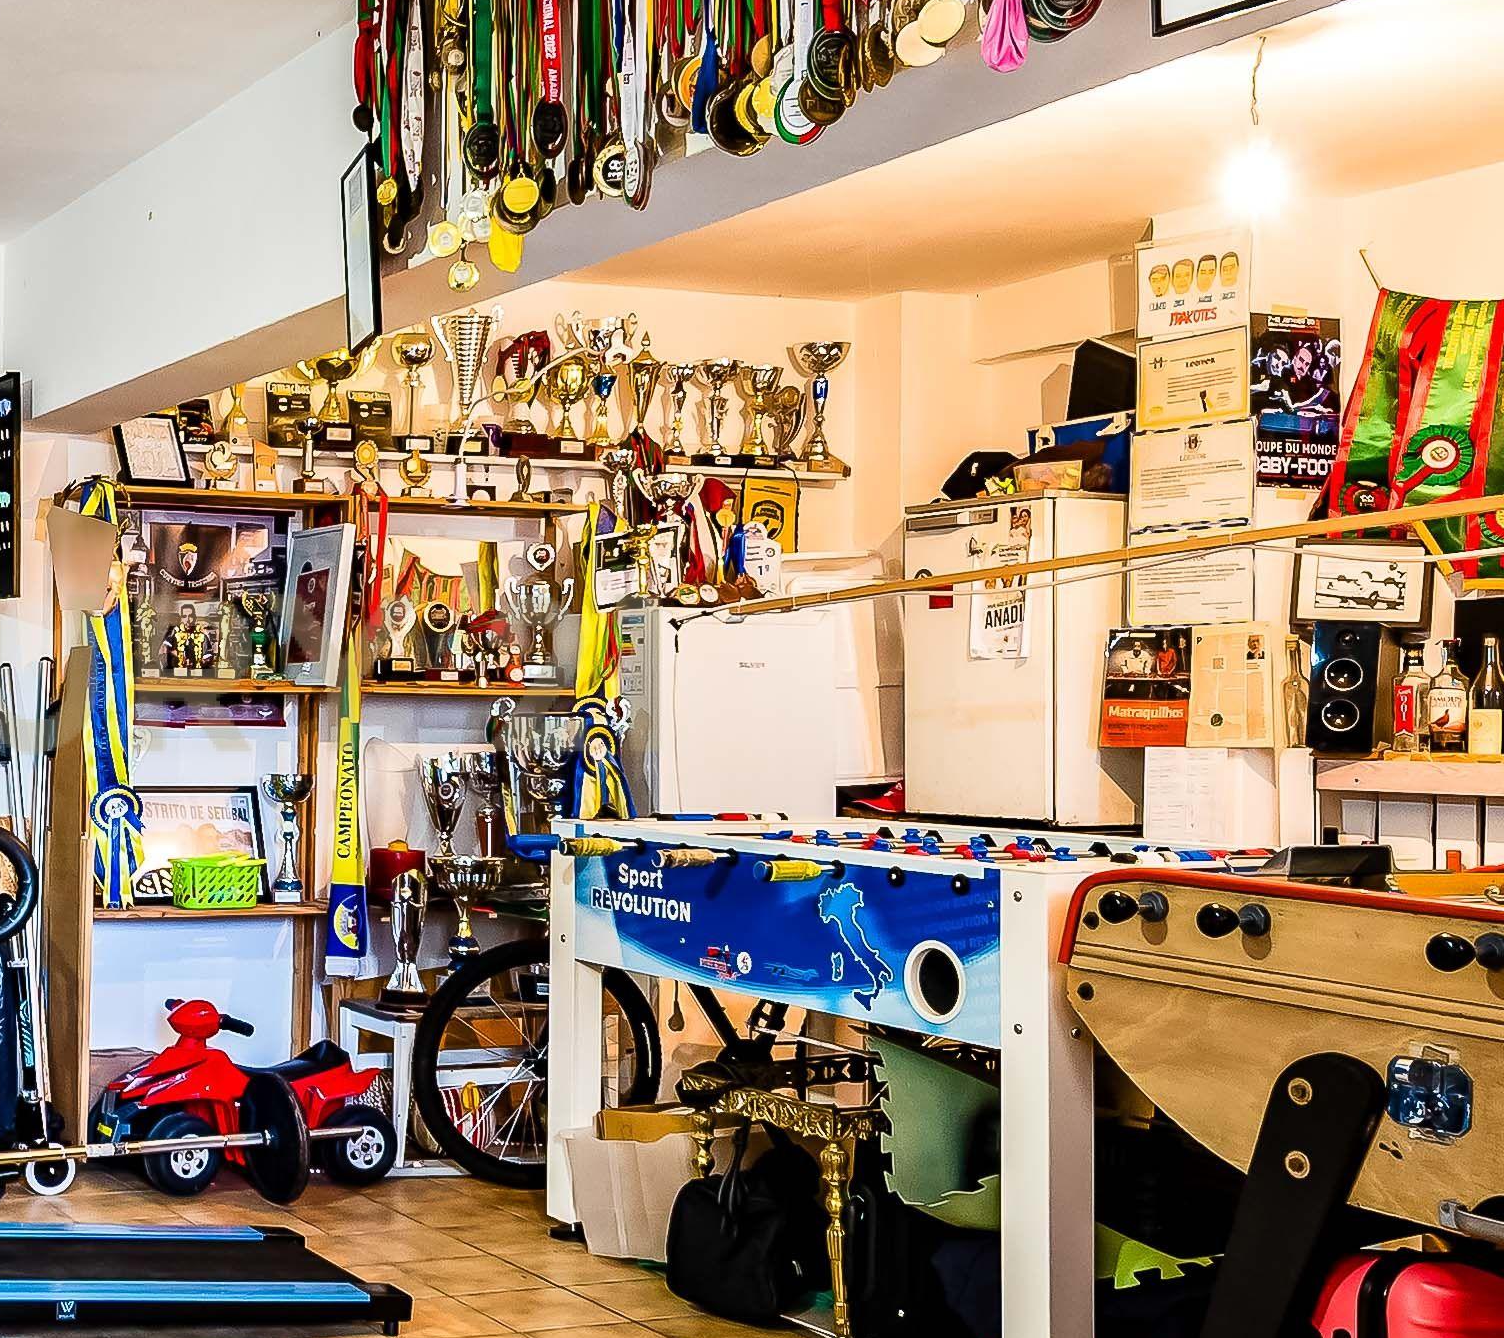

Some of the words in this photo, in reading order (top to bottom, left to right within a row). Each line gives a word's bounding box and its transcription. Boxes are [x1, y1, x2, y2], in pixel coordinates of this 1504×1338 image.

[1255, 441, 1283, 453] OUPE
[1285, 442, 1300, 454] DU
[1302, 443, 1337, 455] MONDE
[1108, 705, 1184, 720] Matraquilhos
[142, 801, 186, 820] STRITO
[191, 803, 205, 820] DE
[336, 742, 357, 860] CAMPEONATO
[618, 863, 663, 889] Sport
[591, 887, 691, 923] REVOLUTION
